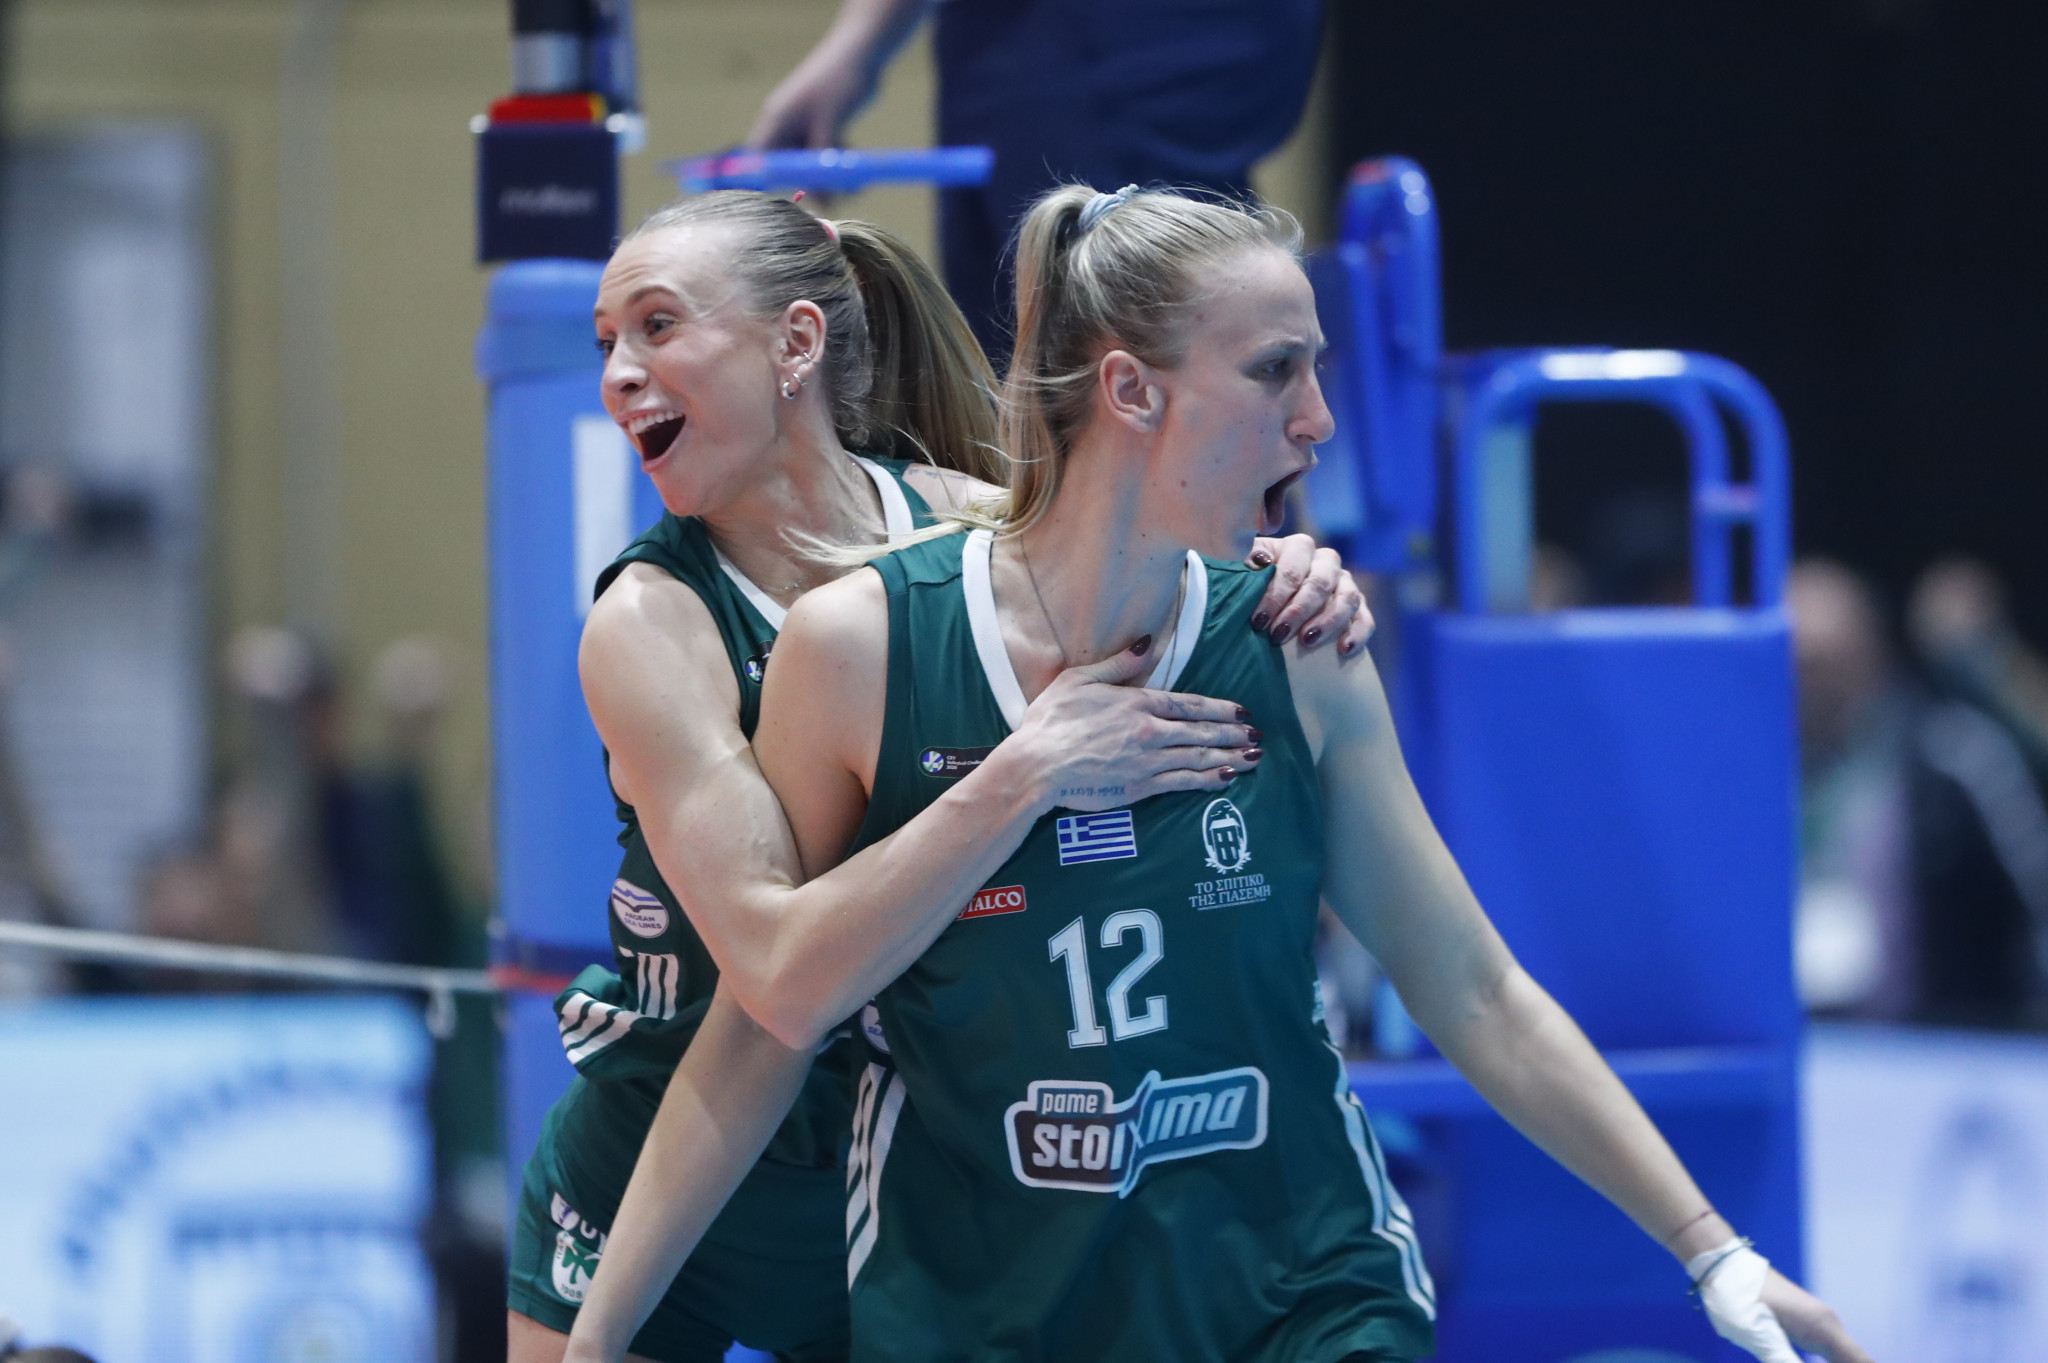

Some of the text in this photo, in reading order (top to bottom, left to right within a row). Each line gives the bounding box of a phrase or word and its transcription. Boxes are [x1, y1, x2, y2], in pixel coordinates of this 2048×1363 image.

[1194, 873, 1264, 894] ΤΟ ΣΠΙΤΙΚΟ
[1188, 884, 1271, 908] ΤΗΣ ΓΙΑΣΕΜΗ
[1048, 908, 1168, 1049] 12
[1041, 1092, 1099, 1115] pame
